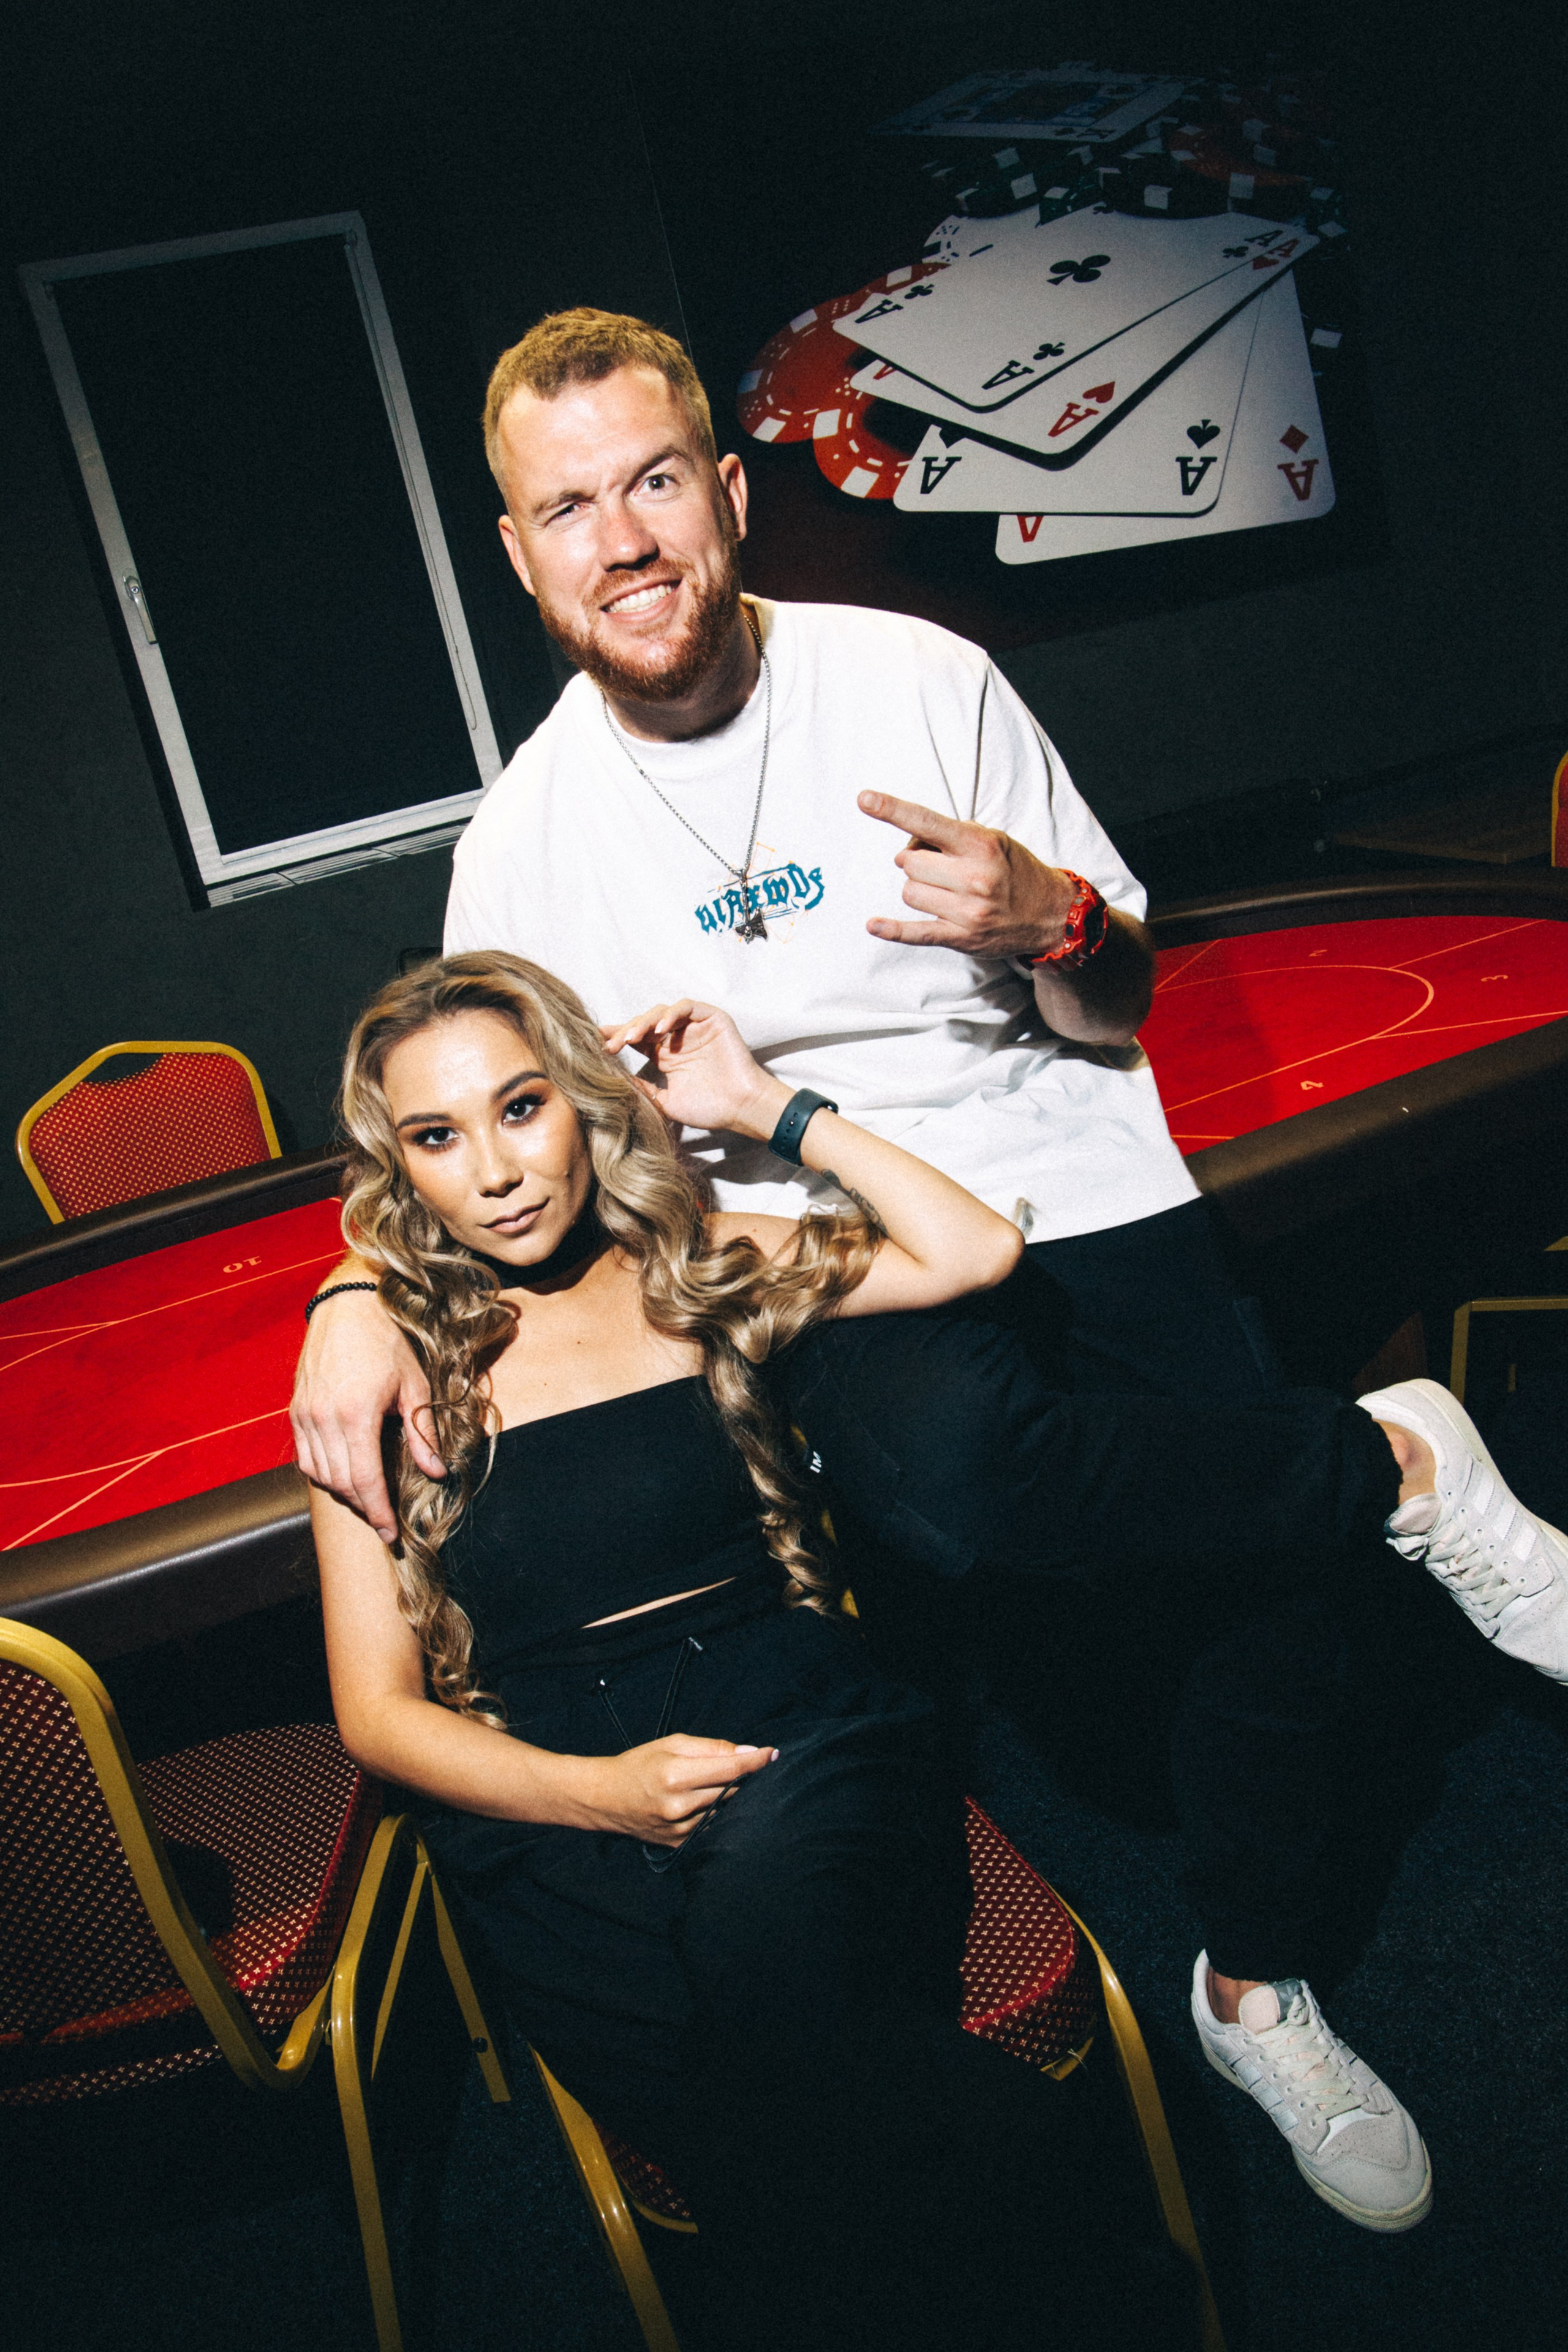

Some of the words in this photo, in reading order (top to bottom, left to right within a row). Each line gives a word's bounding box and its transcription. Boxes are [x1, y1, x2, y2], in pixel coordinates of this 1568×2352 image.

[854, 299, 904, 324] A
[981, 360, 1035, 390] A
[1047, 402, 1100, 438] A
[920, 456, 962, 494] A
[1175, 456, 1218, 496] A
[1277, 458, 1319, 501] A
[1480, 974, 1509, 982] 3
[1300, 1080, 1324, 1091] 4
[222, 1256, 262, 1273] 10
